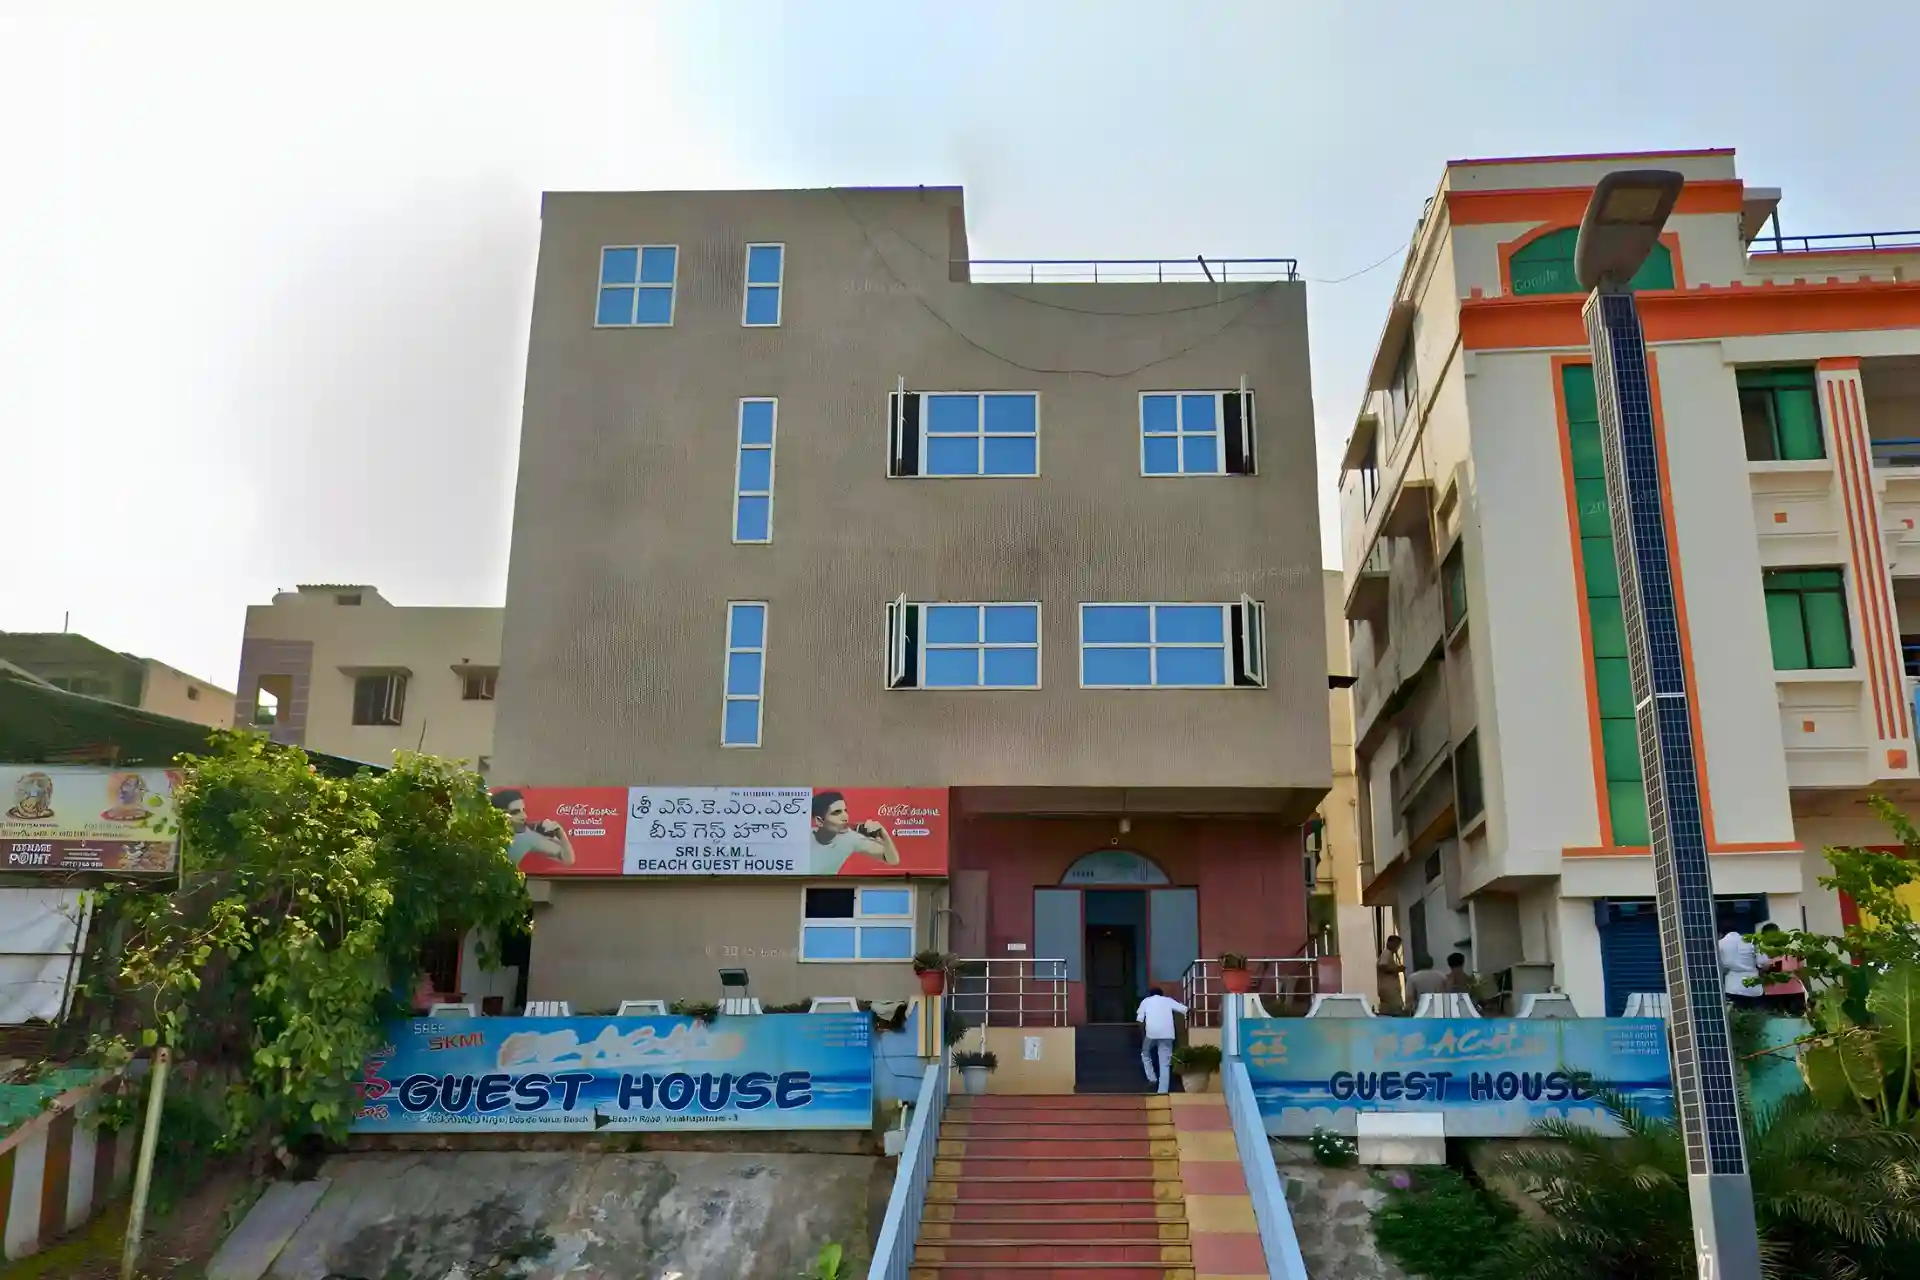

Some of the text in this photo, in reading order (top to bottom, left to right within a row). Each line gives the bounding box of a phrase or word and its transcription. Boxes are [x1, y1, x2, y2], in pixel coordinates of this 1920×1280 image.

[631, 795, 652, 820] శ్రీ
[649, 819, 688, 840] బీచ్
[733, 821, 788, 840] హౌస్
[8, 852, 52, 865] POINT
[675, 846, 757, 858] SRI S.K.M.L.
[638, 859, 794, 871] BEACH GUEST HOUSE
[398, 1072, 594, 1113] GUEST
[617, 1071, 812, 1112] HOUSE
[1329, 1070, 1596, 1101] GUEST HOUSE
